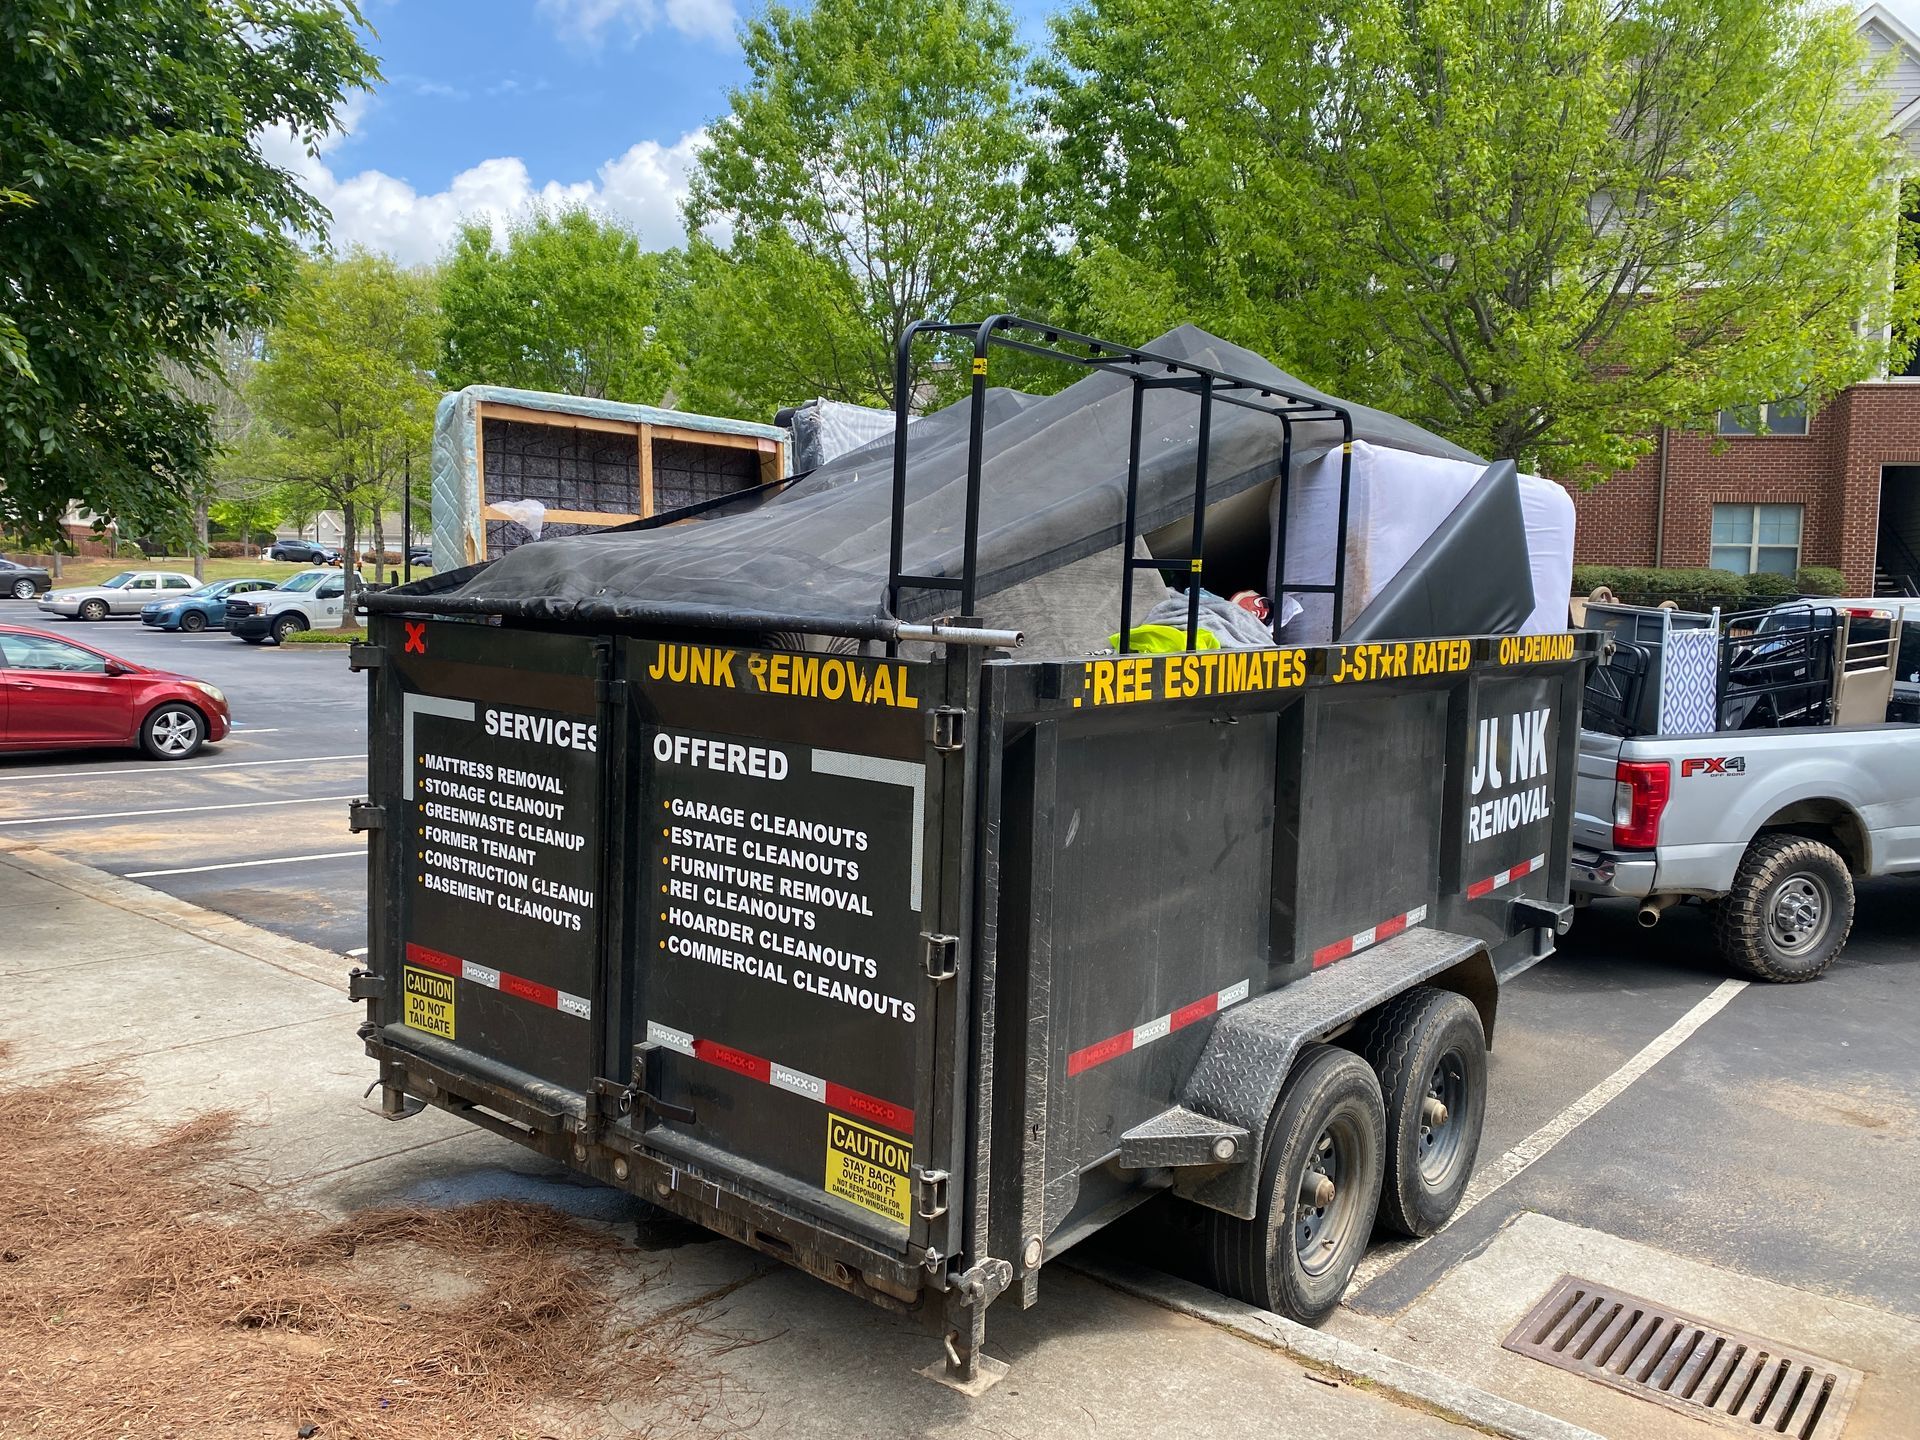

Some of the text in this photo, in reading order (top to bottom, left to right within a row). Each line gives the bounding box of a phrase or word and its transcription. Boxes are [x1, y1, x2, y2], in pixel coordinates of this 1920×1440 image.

[1412, 639, 1471, 676] RATED
[1499, 634, 1575, 666] ON-DEMAND
[648, 643, 919, 709] JUNK REMOVAL
[1164, 648, 1307, 699] ESTIMATES
[485, 709, 597, 752] SERVICES
[425, 753, 564, 795] MATTRESS REMOVAL
[653, 733, 789, 781] OFFERED
[1681, 756, 1746, 777] FX4
[425, 778, 564, 821] STORAGE CLEANOUT
[1468, 785, 1550, 844] REMOVAL
[425, 802, 585, 851] GREENWASTE CLEANUP
[425, 826, 537, 866] FORMER TENANT
[671, 798, 868, 851] GARAGE CLEANOUTS
[425, 849, 528, 890] CONSTRUCTION
[671, 826, 859, 881] ESTATE CLEANOUTS
[425, 873, 582, 931] BASEMENT CLEANOUTS
[670, 854, 873, 917] FURNITURE REMOVAL
[670, 878, 816, 931] REI CLEANOUTS
[669, 907, 878, 979] HOARDER CLEANOUTS
[407, 973, 451, 1001] CAUTION
[668, 935, 916, 1023] COMMERCIAL CLEANOUTS
[409, 1010, 450, 1034] TAILGATE
[412, 997, 446, 1018] DO NOT
[776, 1070, 819, 1093] MAXX-D
[833, 1125, 910, 1173] CAUTION
[836, 1177, 900, 1210] NOT RESPONSIBLE FOR
[842, 1157, 896, 1188] STAY BACK
[842, 1169, 896, 1198] OVER 100 FT
[832, 1184, 905, 1220] DAMAGE TO WINDSHIELDS
